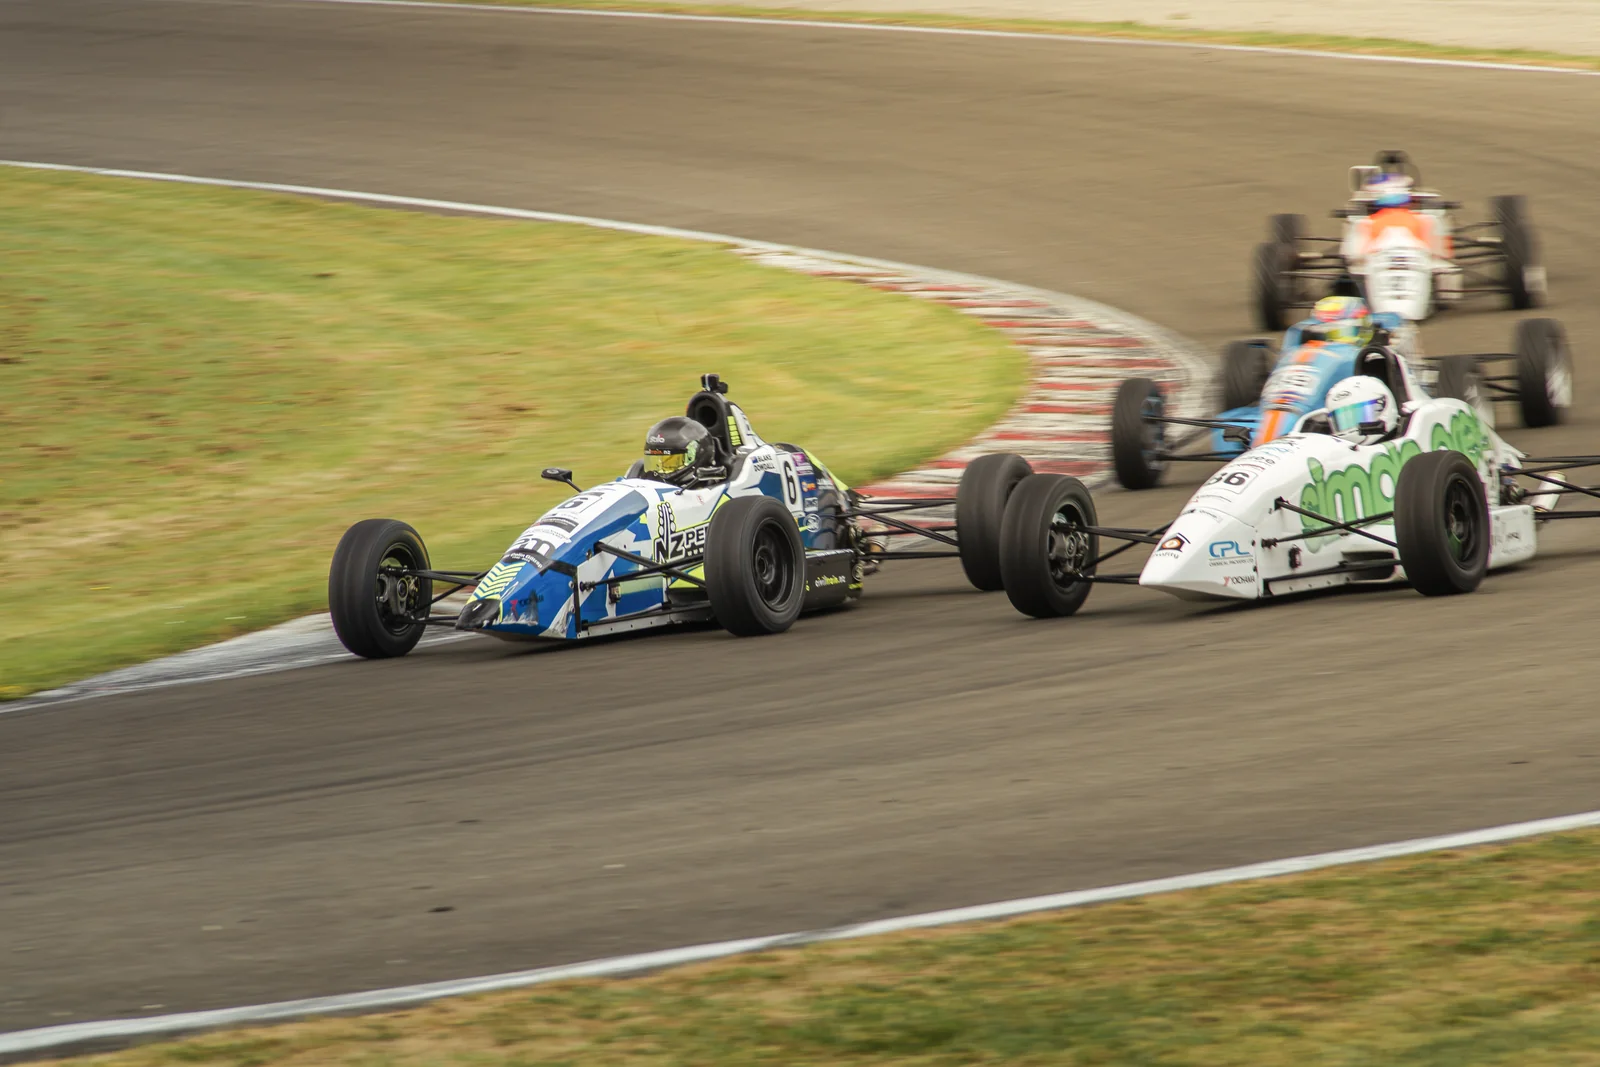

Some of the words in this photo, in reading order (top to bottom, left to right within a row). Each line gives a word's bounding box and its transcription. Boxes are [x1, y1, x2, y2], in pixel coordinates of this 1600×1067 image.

[784, 461, 797, 505] 6
[556, 497, 588, 509] 6
[655, 532, 685, 564] NZ
[1208, 540, 1251, 558] CPL
